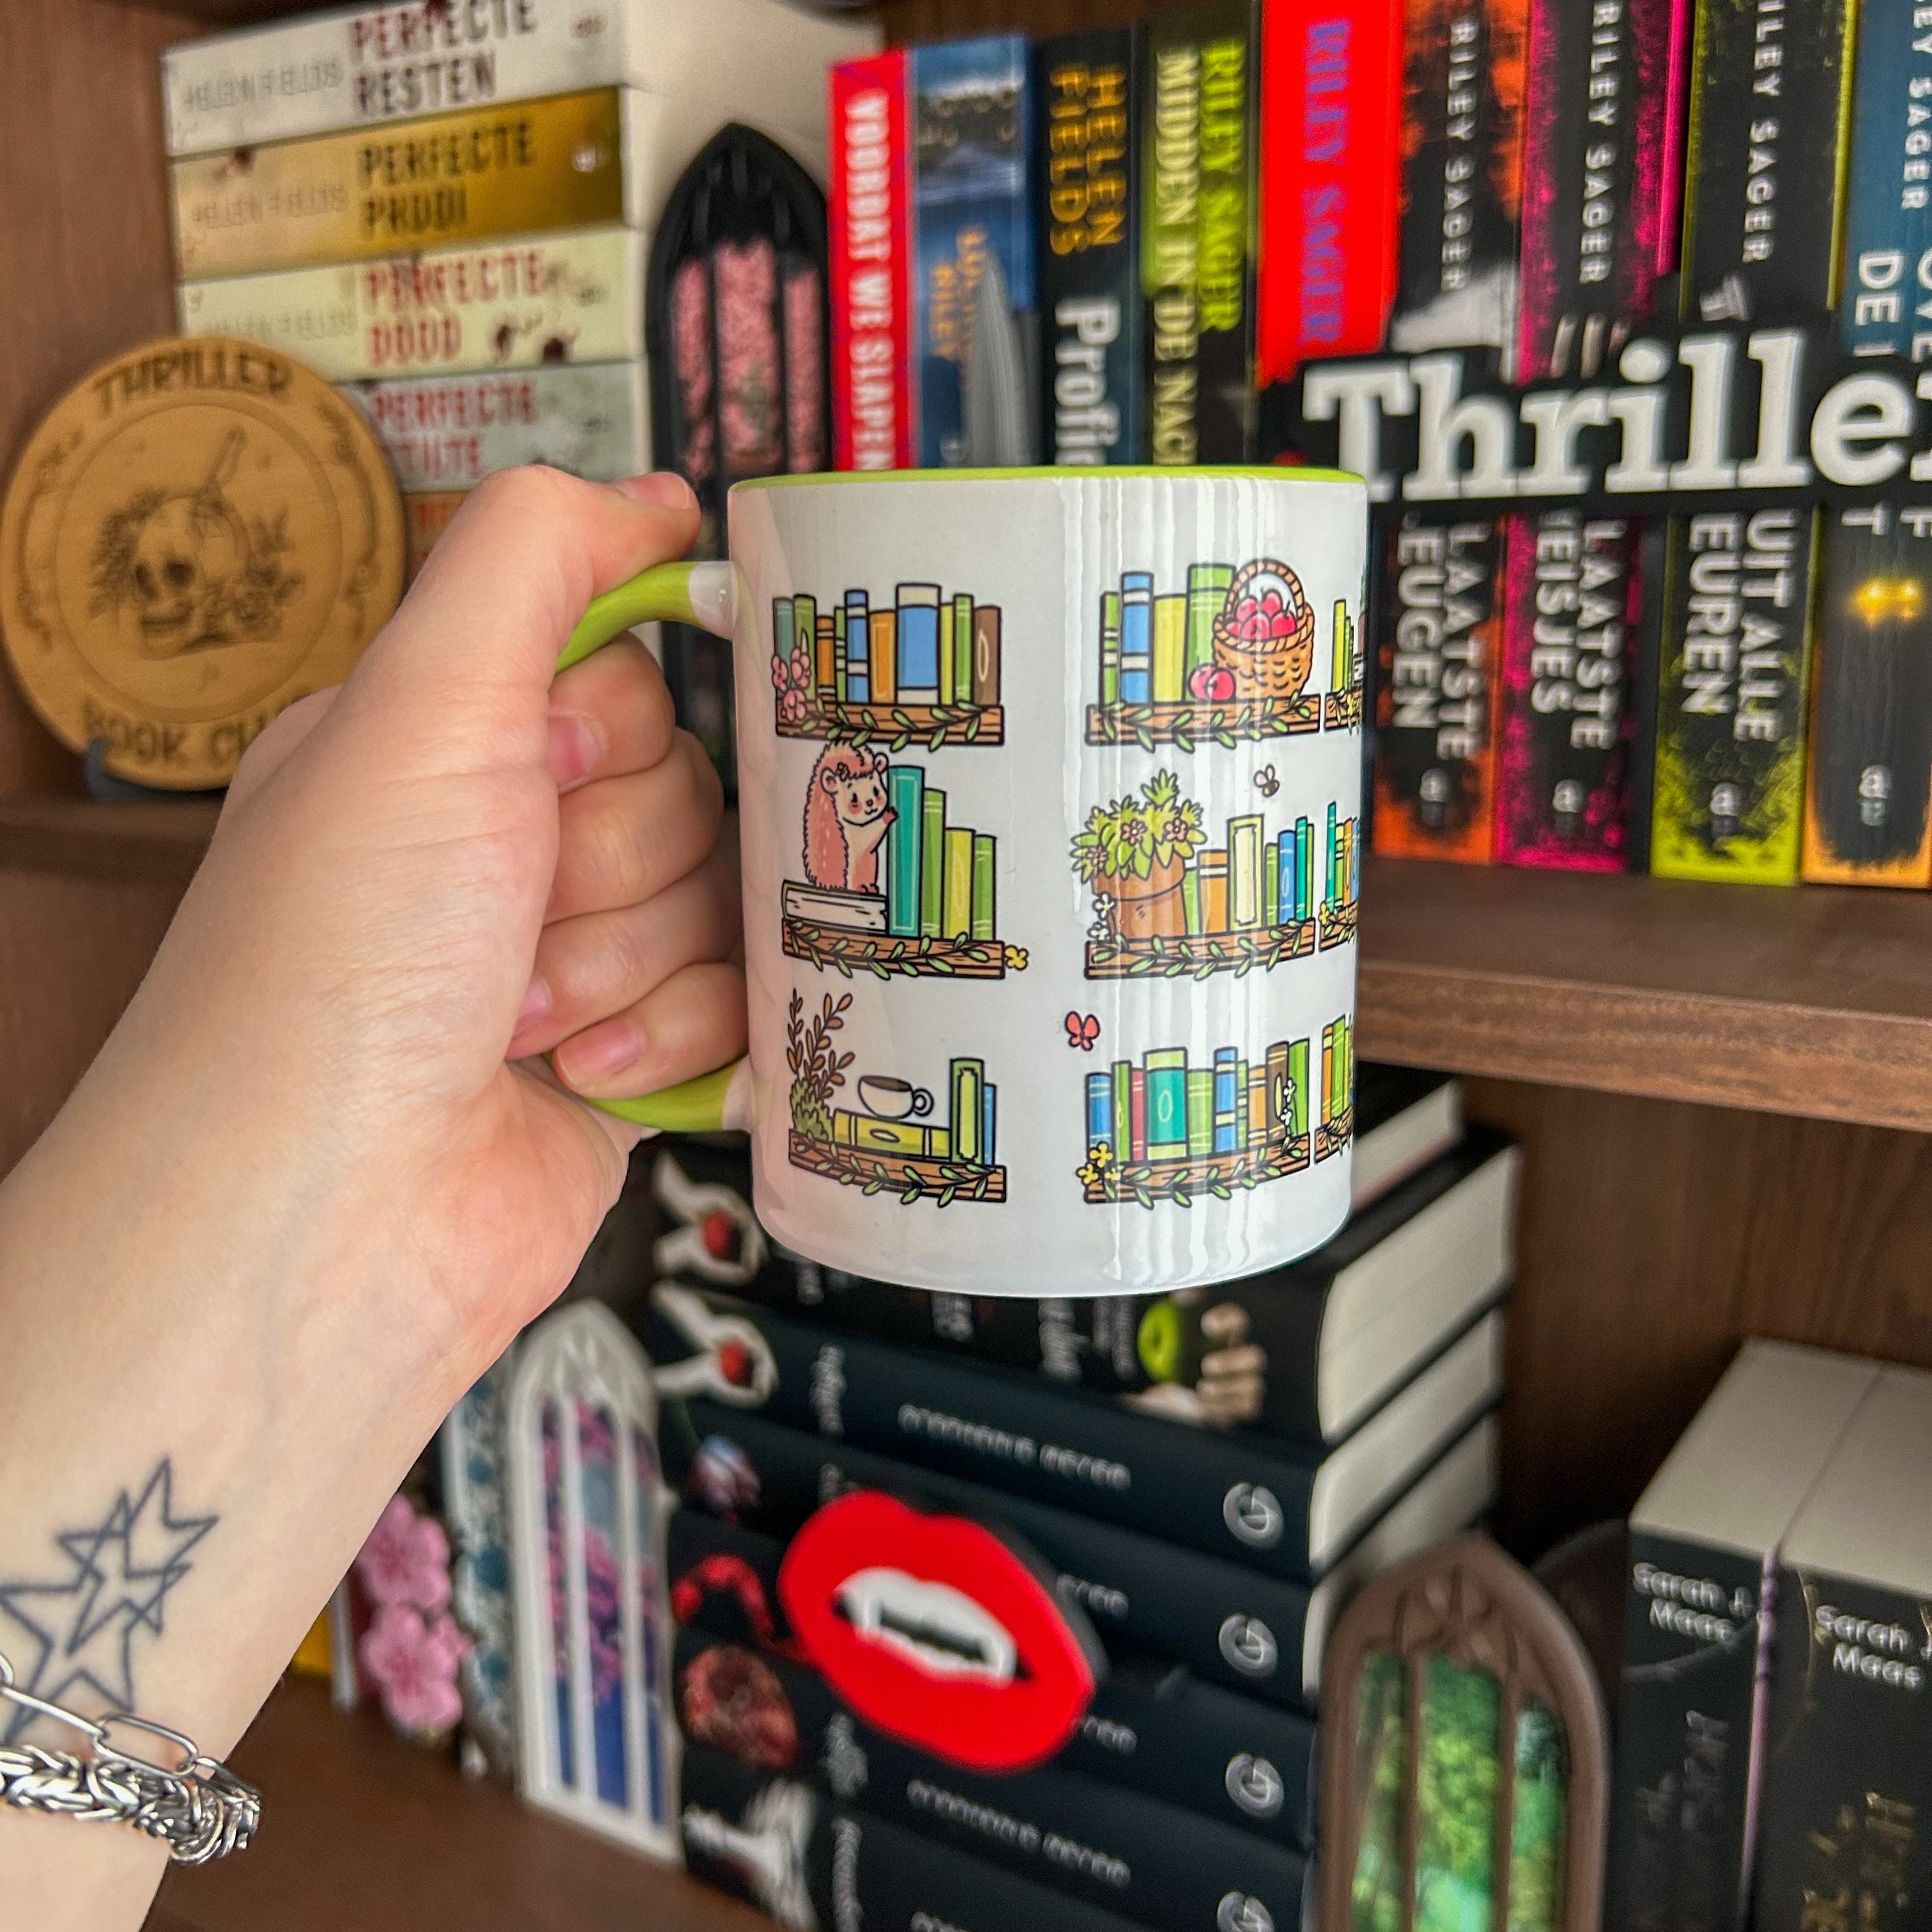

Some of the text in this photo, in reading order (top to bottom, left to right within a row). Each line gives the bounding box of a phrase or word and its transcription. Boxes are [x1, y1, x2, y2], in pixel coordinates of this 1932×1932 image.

[845, 88, 891, 262] VOORDAT
[1050, 64, 1088, 254] FIELDS
[1087, 66, 1126, 247] HELEN
[1156, 46, 1199, 226] MIDDEN
[1303, 18, 1348, 165] RILEY
[1440, 17, 1478, 291] RILEY SAGER
[1579, 0, 1623, 284] RILEY SAGER
[1742, 0, 1786, 263] ILEY SAGER
[1902, 77, 1932, 209] SAGER
[848, 268, 893, 328] WE
[1154, 291, 1199, 361] DE
[1156, 234, 1199, 288] IN
[1302, 330, 1932, 502] Thrille
[1436, 523, 1492, 760] LAATSTE
[1570, 519, 1628, 749] LAATSTE
[1682, 512, 1740, 714] EUREN
[1733, 511, 1795, 742] UIT ALLE
[1633, 1562, 1725, 1611] Sarah
[1650, 1598, 1736, 1643] Maas
[1815, 1605, 1913, 1655] Sarah
[1833, 1642, 1922, 1690] Maas
